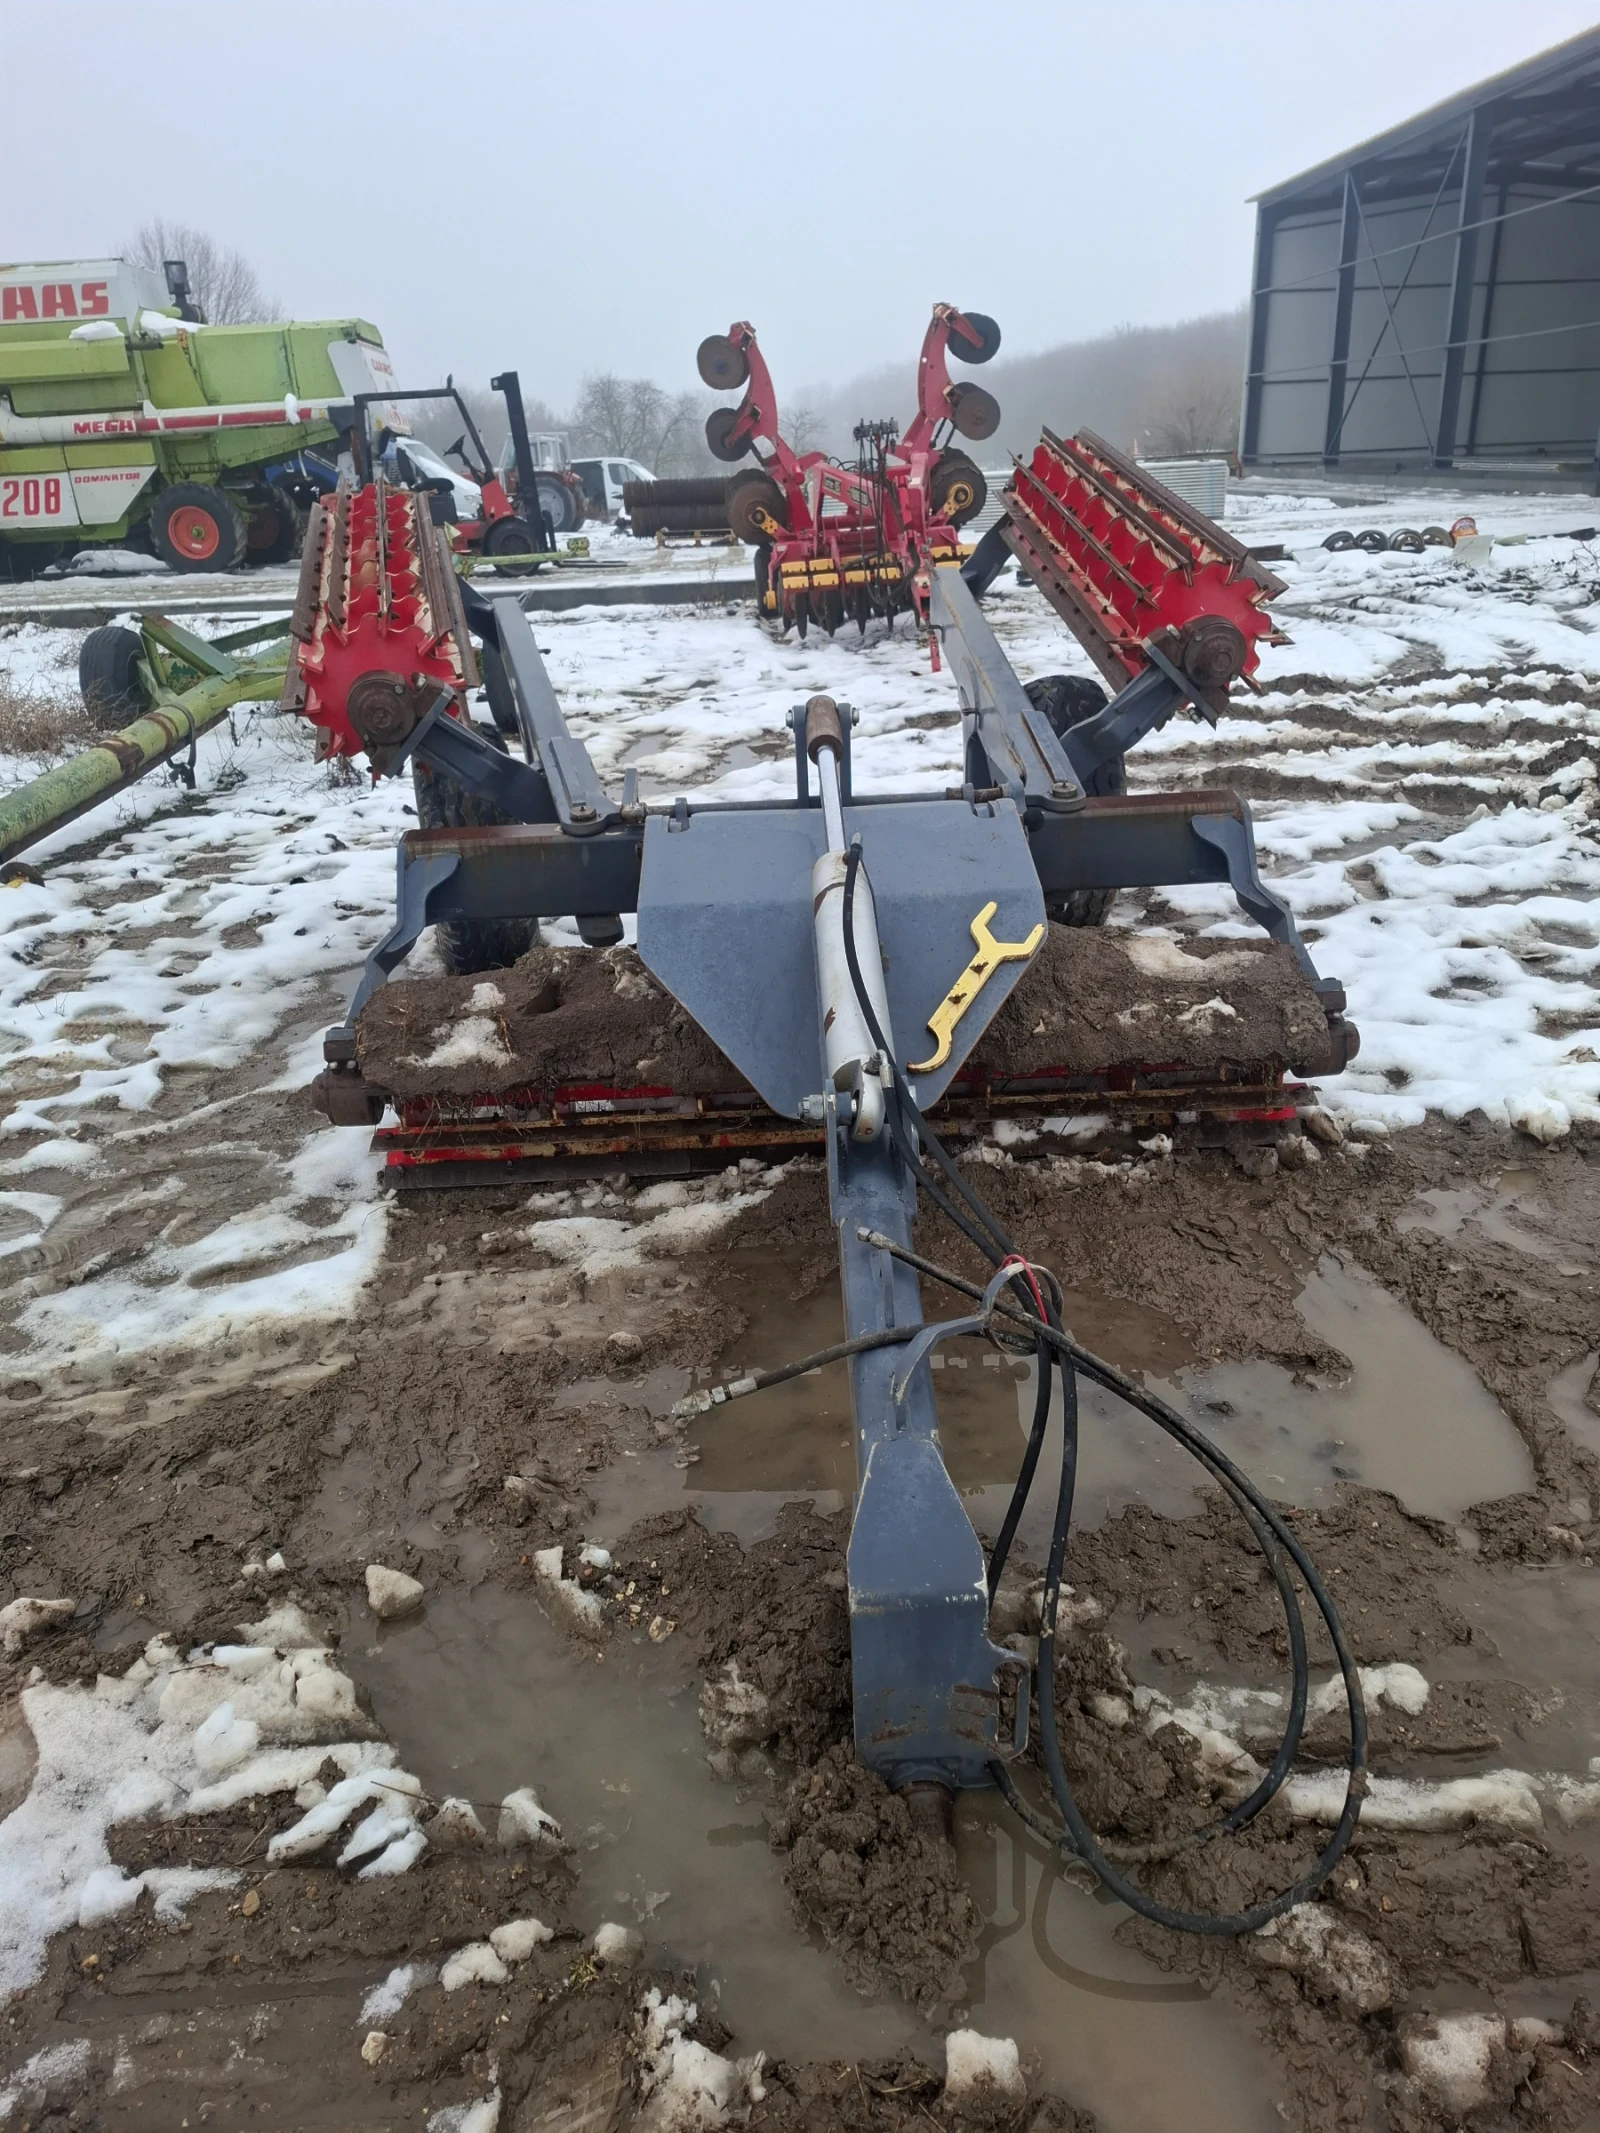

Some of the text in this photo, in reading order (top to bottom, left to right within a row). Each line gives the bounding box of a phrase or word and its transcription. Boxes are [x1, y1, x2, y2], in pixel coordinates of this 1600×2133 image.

[73, 419, 134, 434] MEGA
[74, 472, 140, 484] DOMINATOR
[2, 478, 61, 517] 208
